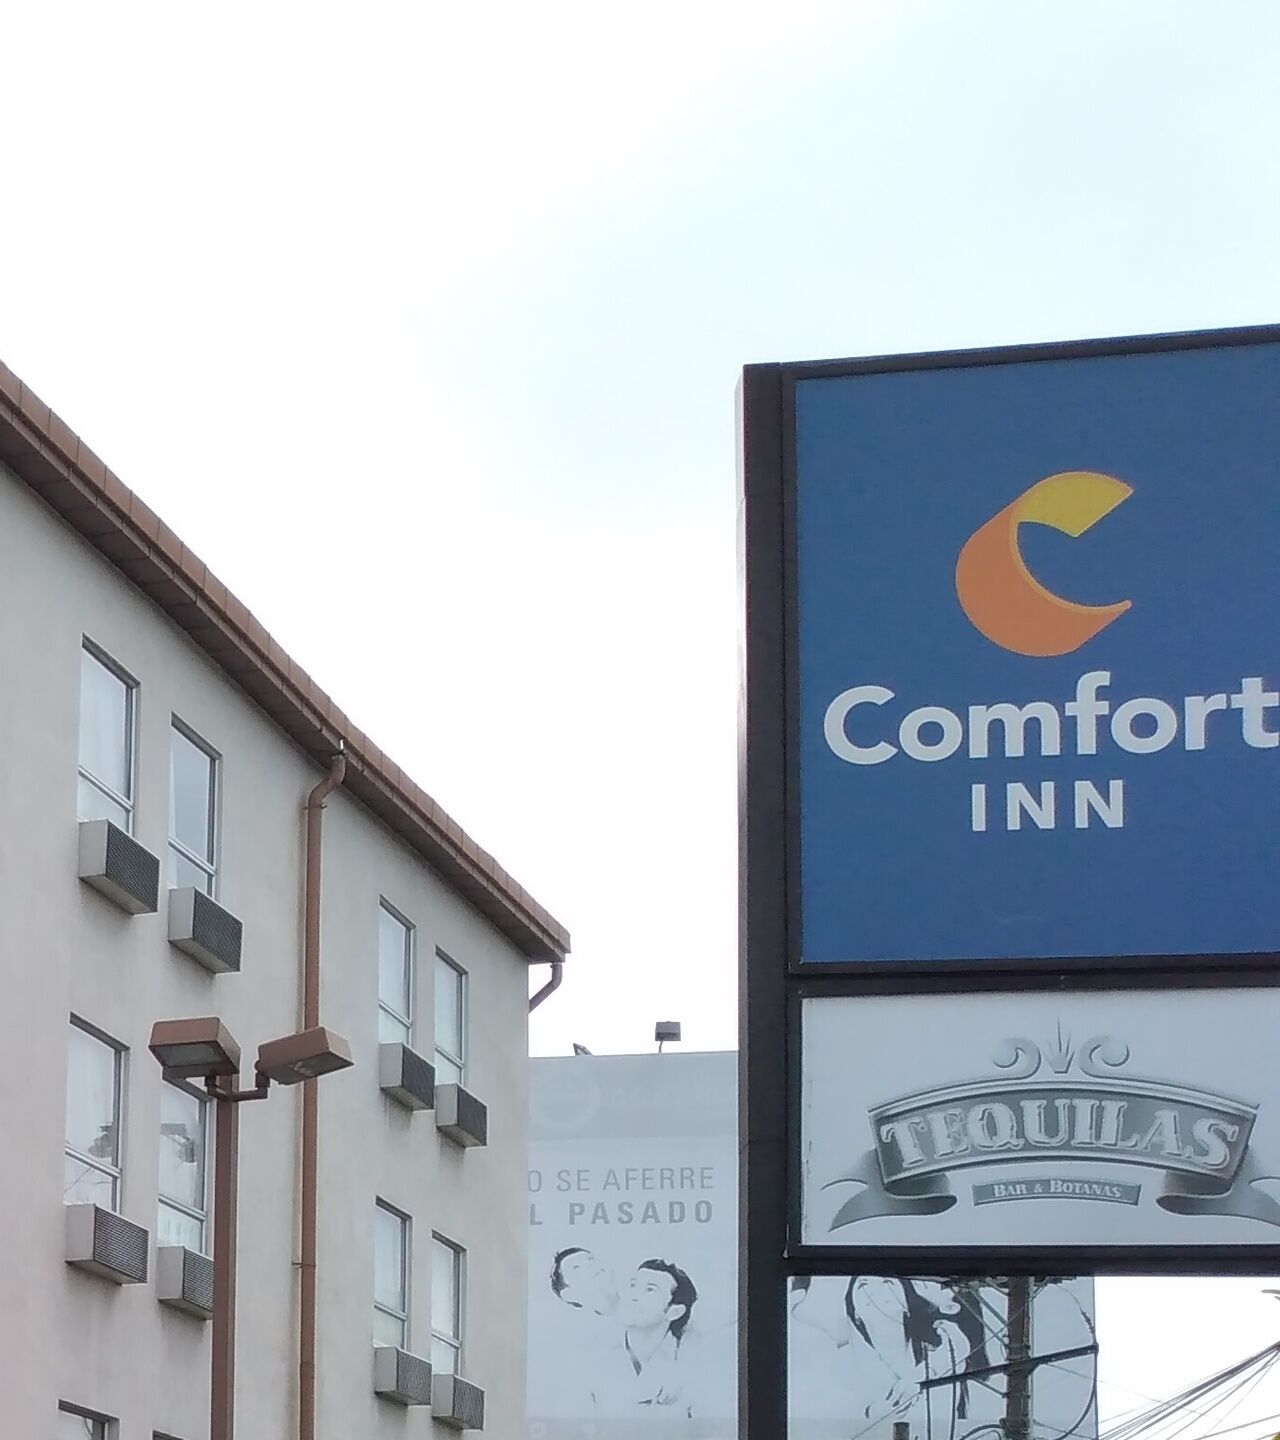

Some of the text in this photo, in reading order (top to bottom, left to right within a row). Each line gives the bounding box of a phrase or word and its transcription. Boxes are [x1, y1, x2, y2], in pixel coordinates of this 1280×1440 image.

[823, 670, 1280, 765] Comfort
[971, 779, 1125, 832] INN
[880, 1098, 1240, 1169] TEQUILAS
[556, 1169, 591, 1192] SE
[602, 1167, 715, 1191] AFERRE
[993, 1180, 1121, 1198] BAR & BOTANAS
[569, 1200, 713, 1226] PASADO
